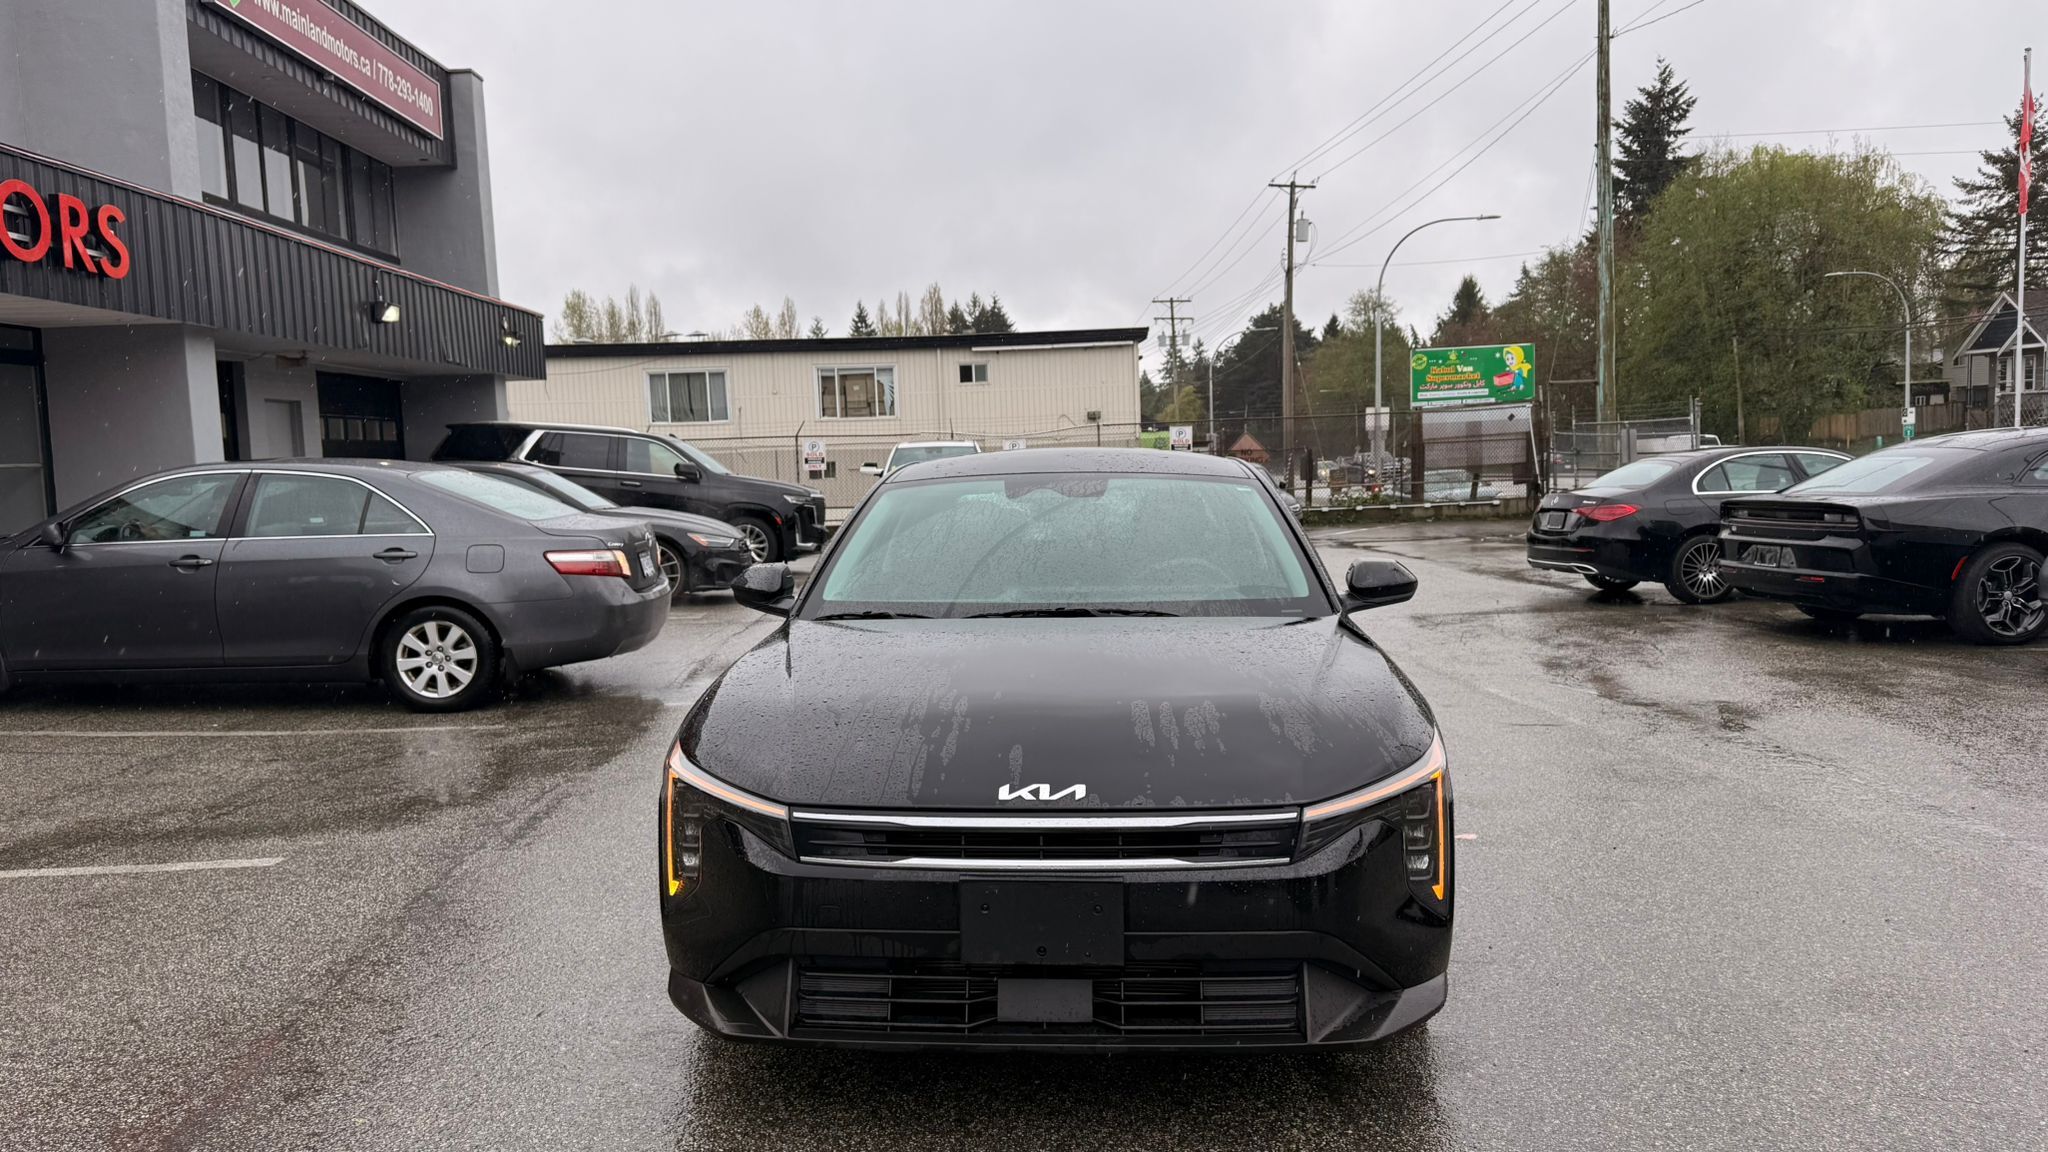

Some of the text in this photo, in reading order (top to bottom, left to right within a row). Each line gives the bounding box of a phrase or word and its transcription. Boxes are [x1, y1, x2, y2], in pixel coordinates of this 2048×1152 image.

[377, 62, 434, 117] 778-293-1400
[1426, 372, 1481, 383] Supermarket
[998, 773, 1087, 801] KIA
